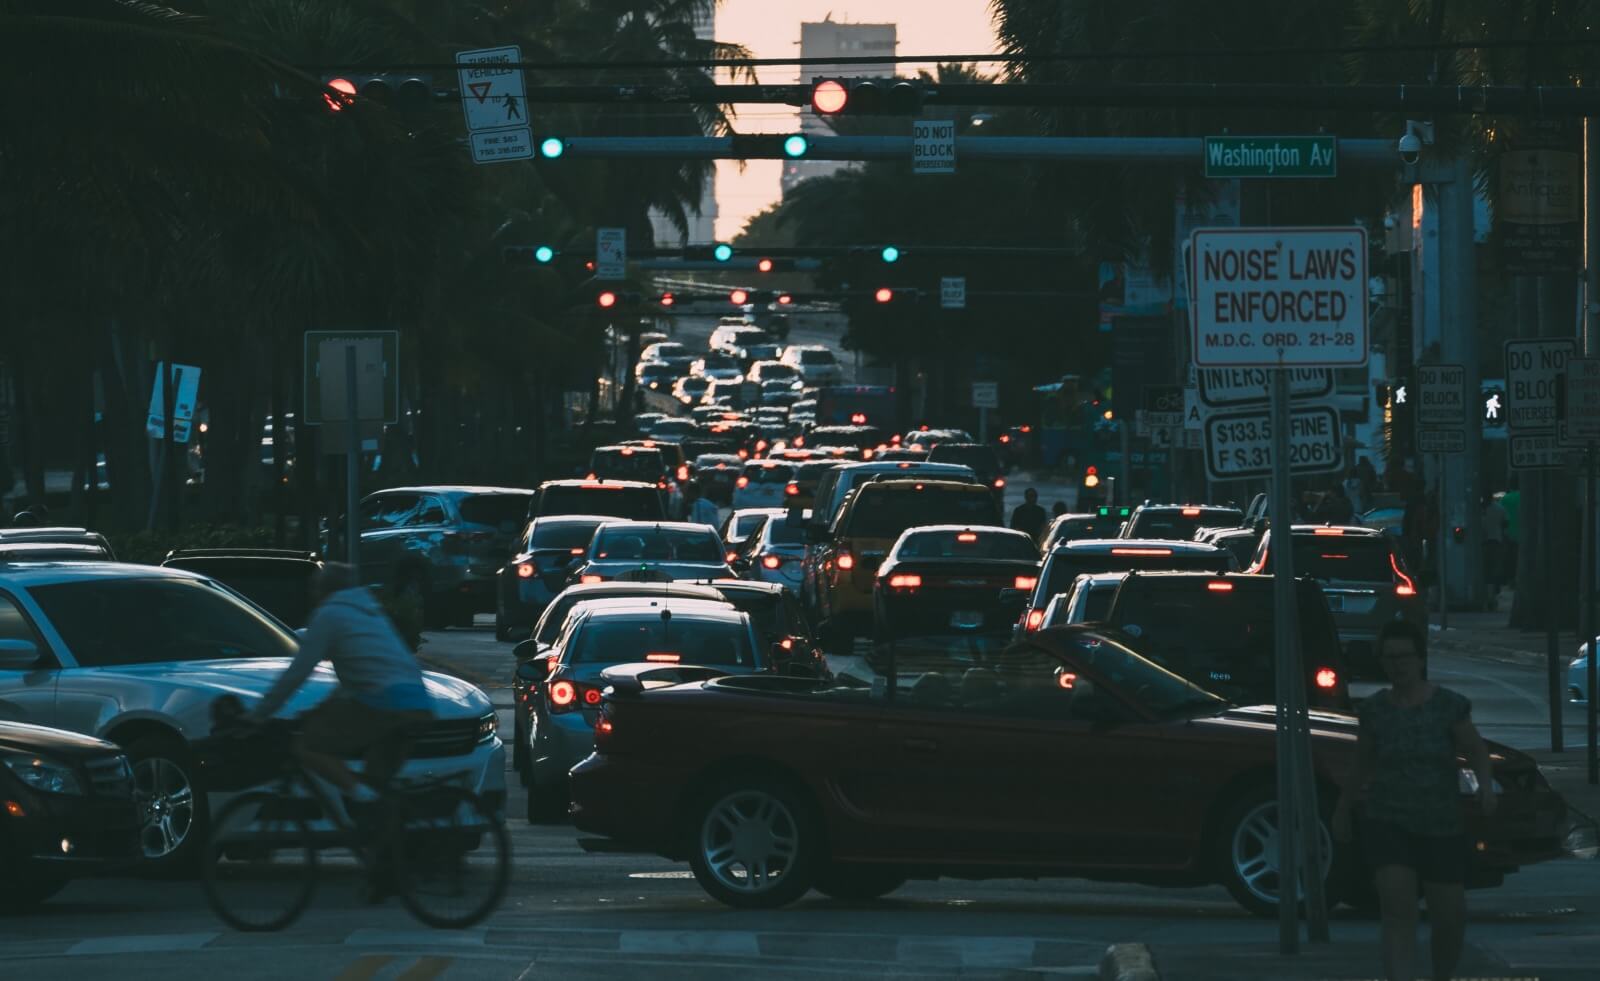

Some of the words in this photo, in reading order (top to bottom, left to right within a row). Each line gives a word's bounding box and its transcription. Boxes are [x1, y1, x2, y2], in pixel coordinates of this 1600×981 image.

[914, 126, 929, 139] DO
[932, 126, 952, 139] NOT
[914, 144, 953, 156] BLOCK
[1208, 142, 1300, 174] Washington
[1309, 143, 1333, 167] Av
[1204, 249, 1278, 281] NOISE
[1288, 248, 1356, 281] LAWS
[1215, 290, 1346, 323] ENFORCED
[1205, 333, 1255, 347] M.D.C.
[1262, 333, 1302, 347] ORD.
[1308, 332, 1355, 347] 21-28
[1510, 351, 1532, 371] DO
[1420, 371, 1436, 385] DO
[1441, 371, 1463, 385] NOT
[1423, 391, 1460, 405] BLOCK
[1515, 380, 1557, 400] BLOC
[1290, 415, 1329, 438] FINE
